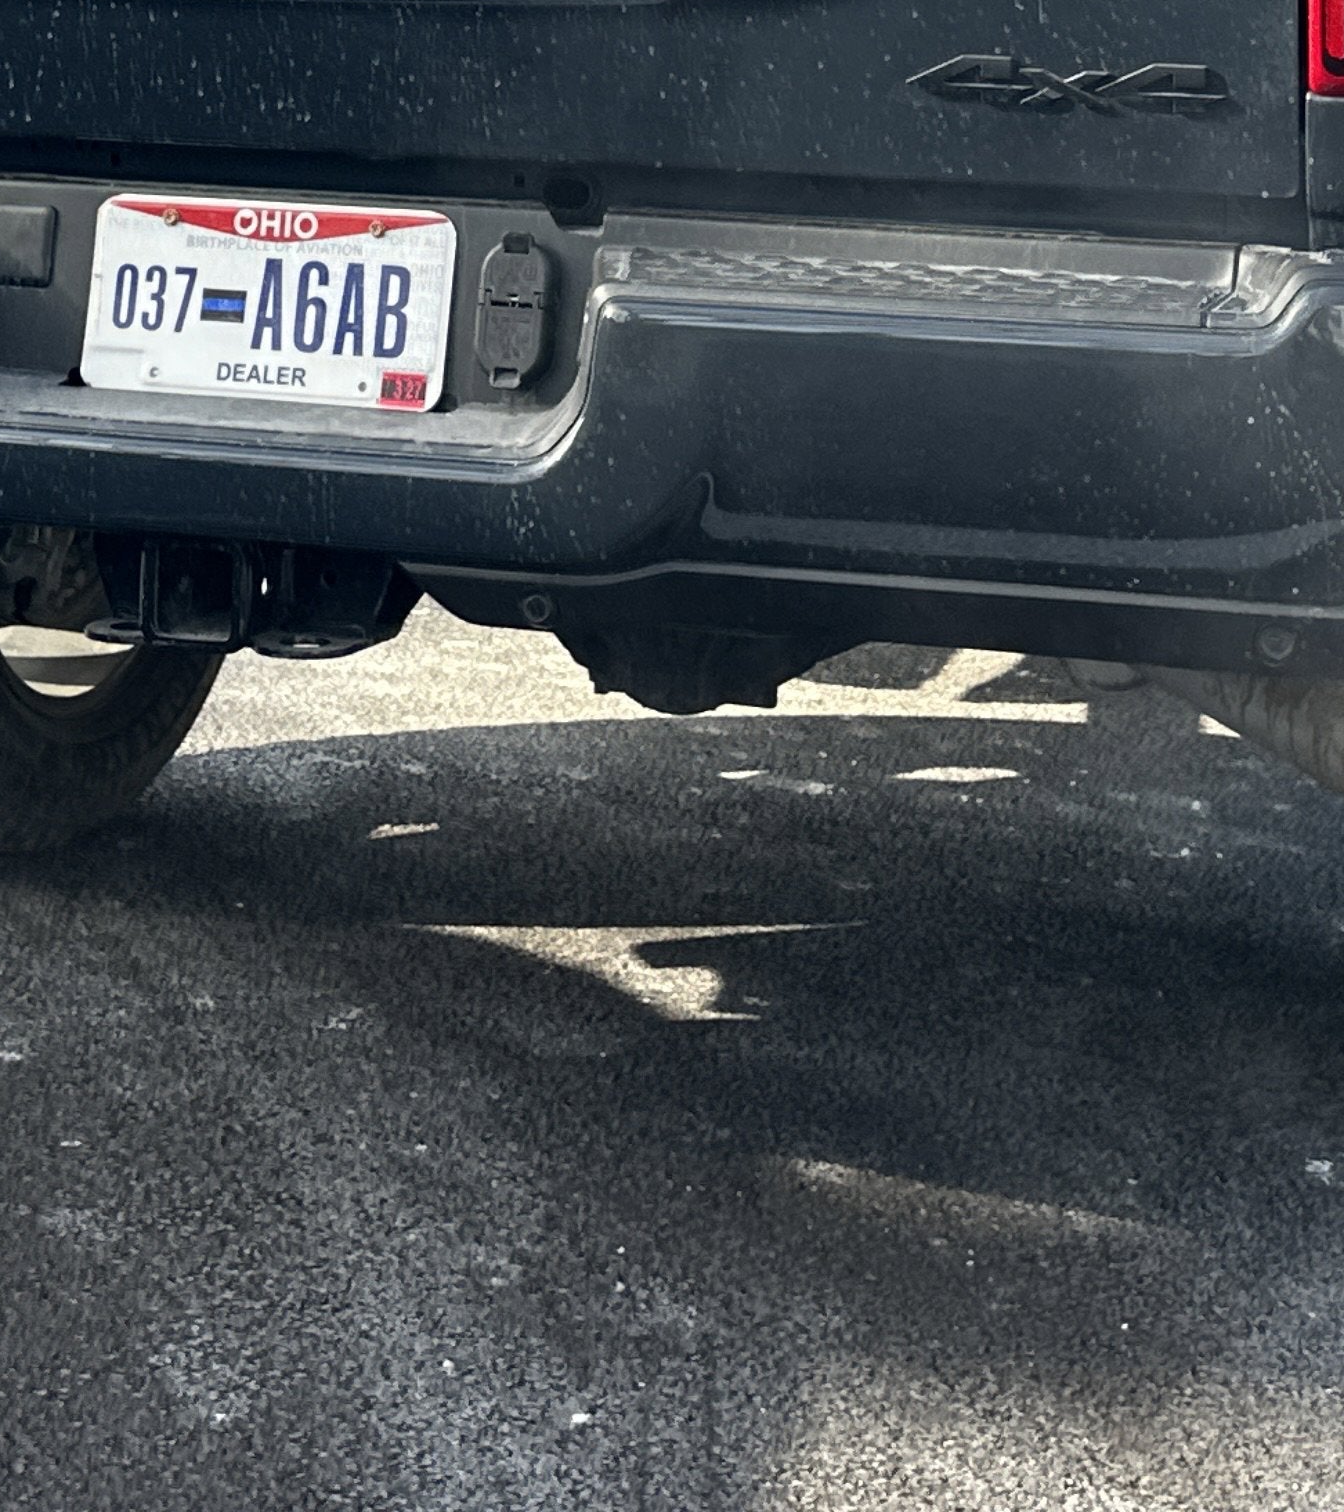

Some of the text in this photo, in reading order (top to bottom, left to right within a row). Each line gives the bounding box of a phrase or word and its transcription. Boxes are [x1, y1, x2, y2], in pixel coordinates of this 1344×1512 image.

[233, 208, 319, 239] OHIO
[186, 234, 271, 251] BIRTHPLACE
[295, 242, 363, 256] AVIATION
[111, 257, 410, 359] 037 A6AB
[216, 362, 306, 387] DEALER
